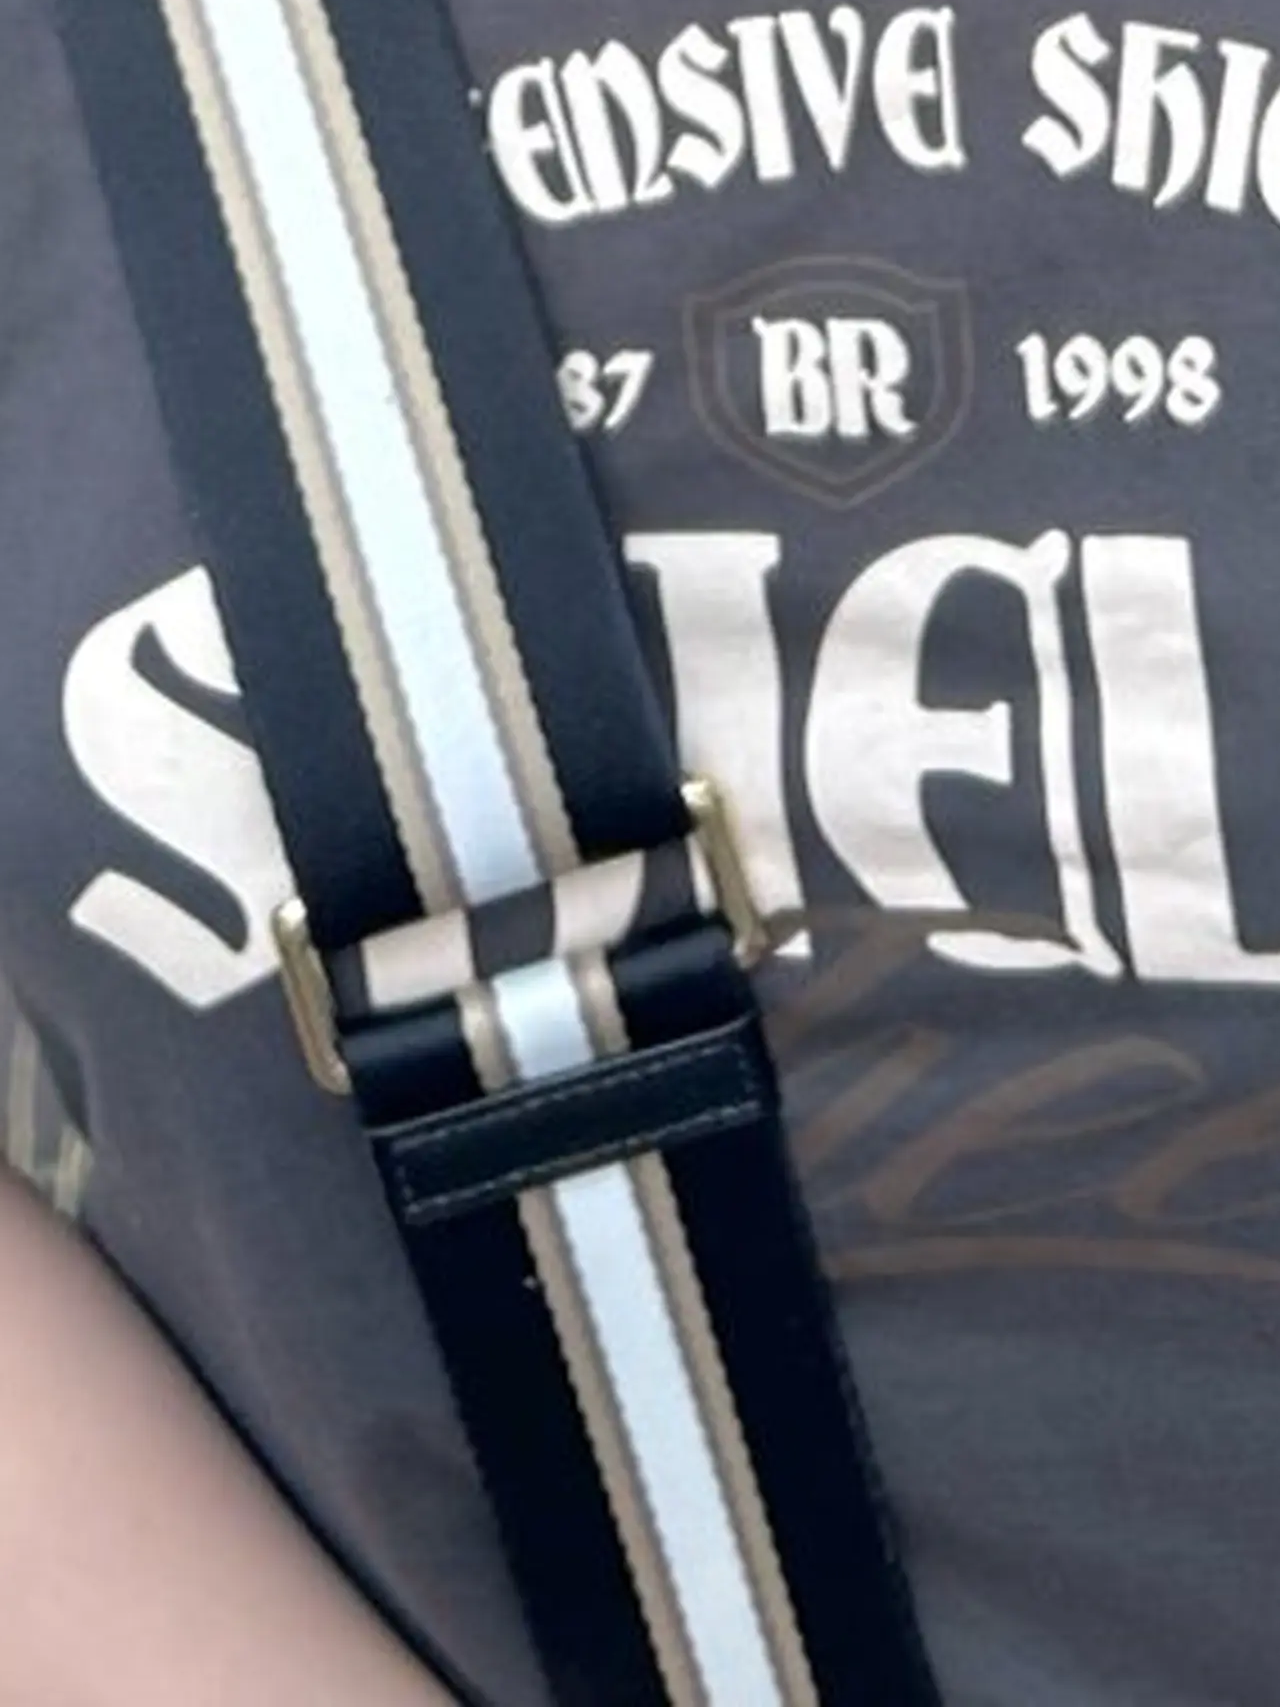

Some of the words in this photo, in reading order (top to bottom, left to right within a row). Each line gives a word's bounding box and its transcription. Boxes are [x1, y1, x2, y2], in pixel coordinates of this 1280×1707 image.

[472, 4, 965, 222] ENSIVE
[556, 347, 655, 433] 87
[753, 316, 915, 440] BR
[1017, 331, 1222, 425] 1998
